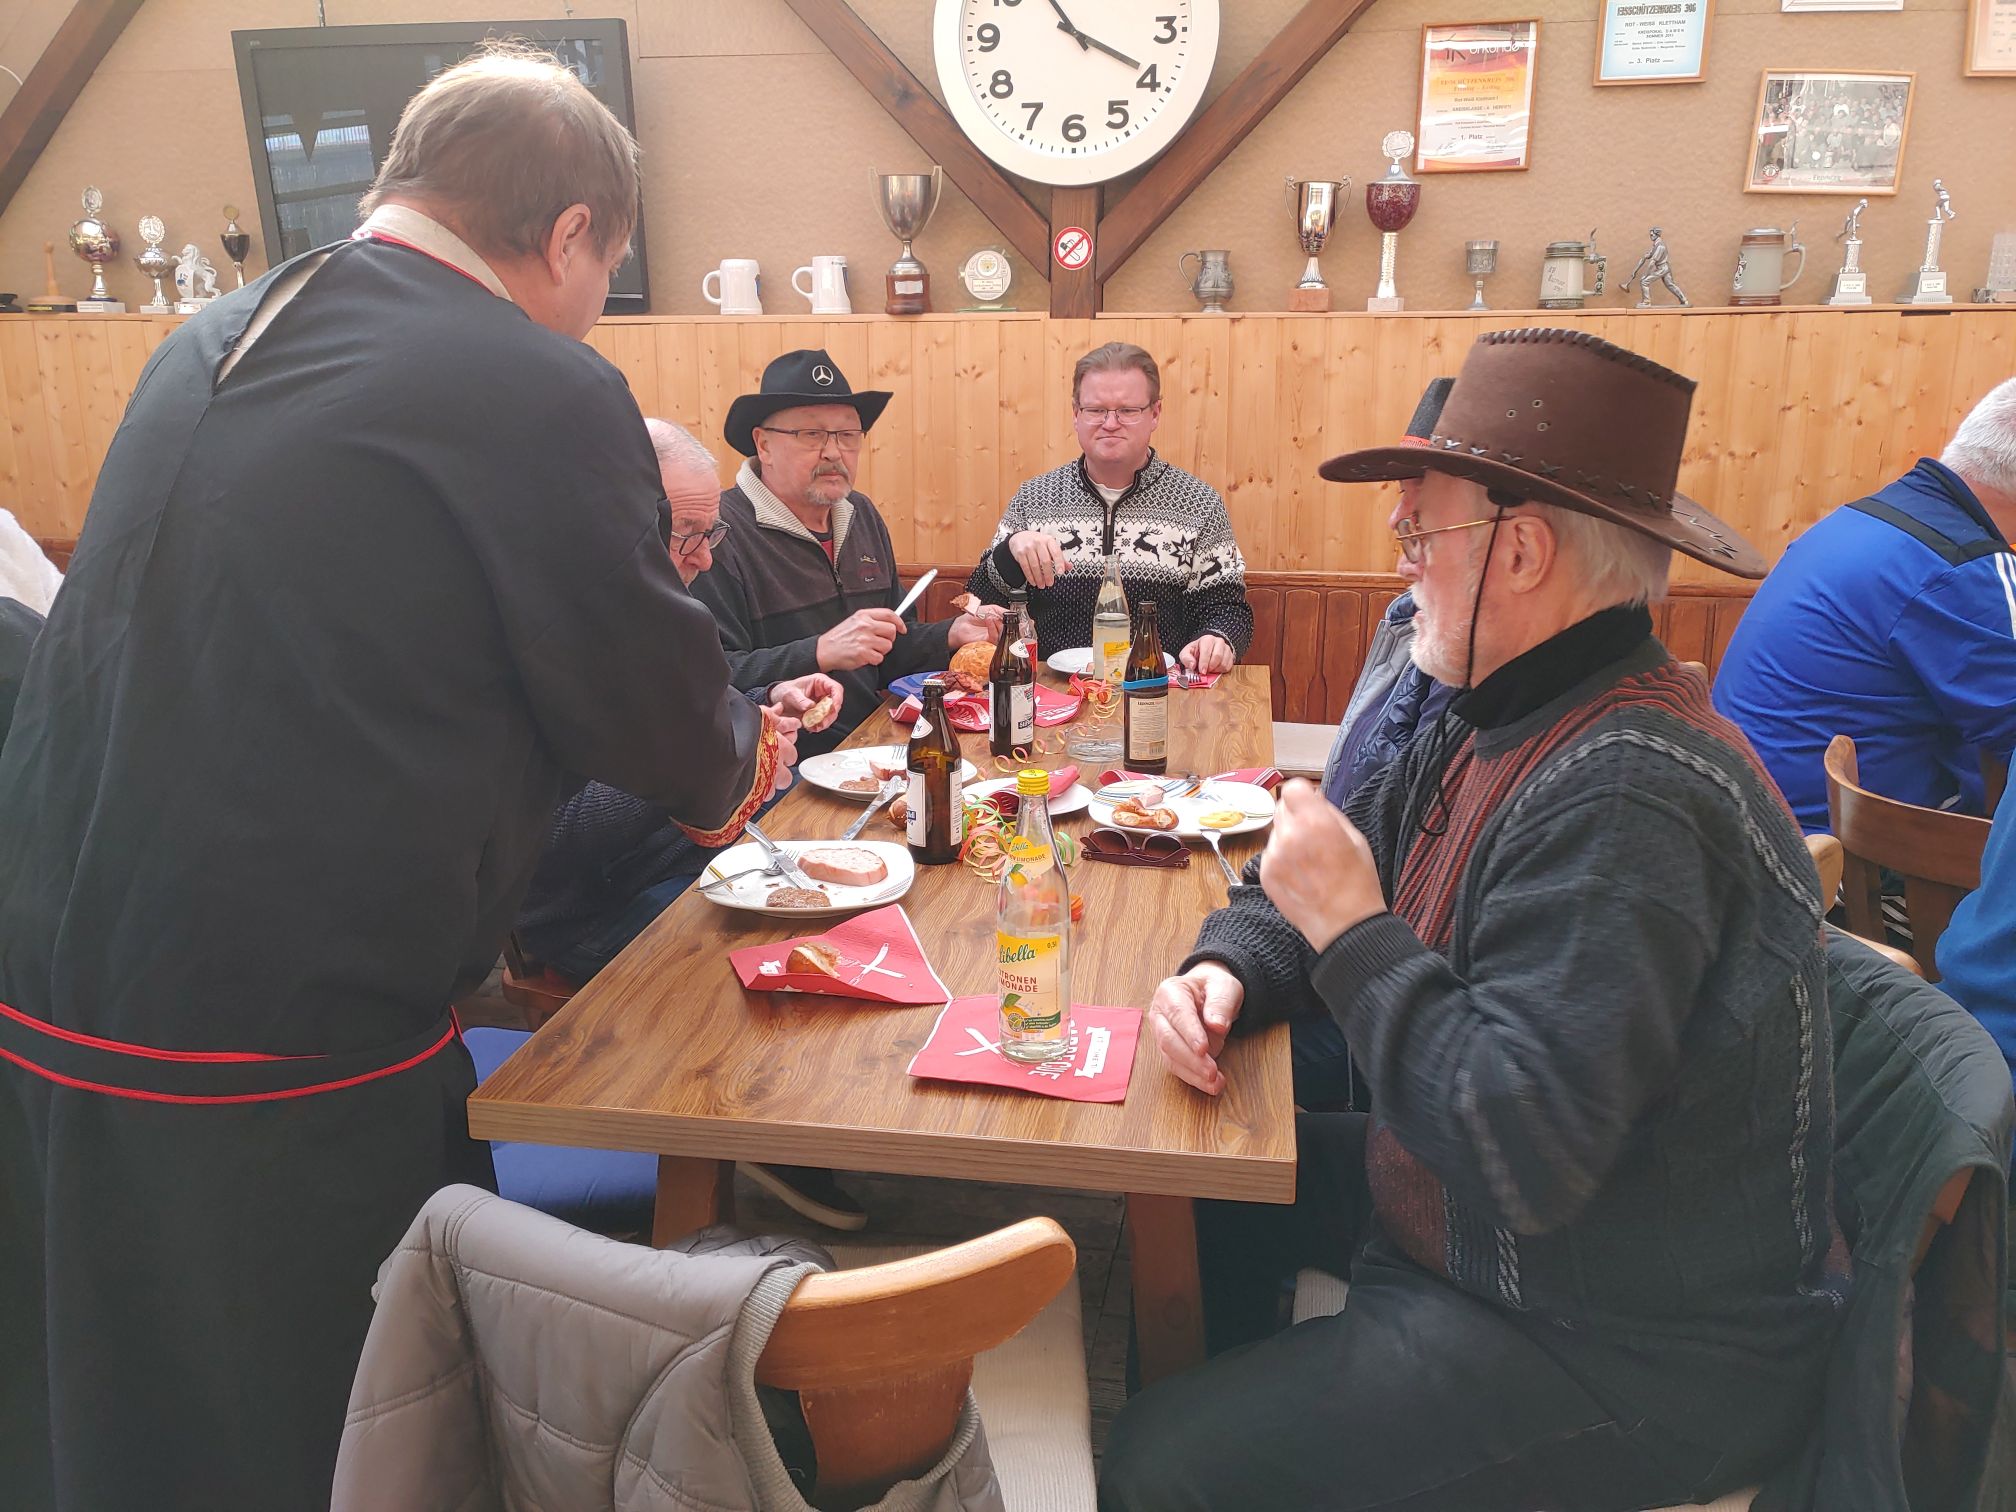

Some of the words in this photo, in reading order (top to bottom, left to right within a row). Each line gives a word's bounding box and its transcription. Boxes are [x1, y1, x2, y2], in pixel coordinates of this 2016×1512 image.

[977, 23, 1001, 53] 9
[1153, 16, 1177, 44] 3
[989, 69, 1013, 99] 8
[1136, 63, 1161, 93] 4
[1021, 102, 1043, 131] 7
[1061, 114, 1087, 143] 6
[1105, 100, 1130, 129] 5
[1000, 944, 1036, 964] libella
[999, 968, 1037, 984] ITRONEN
[999, 976, 1038, 992] MONADE
